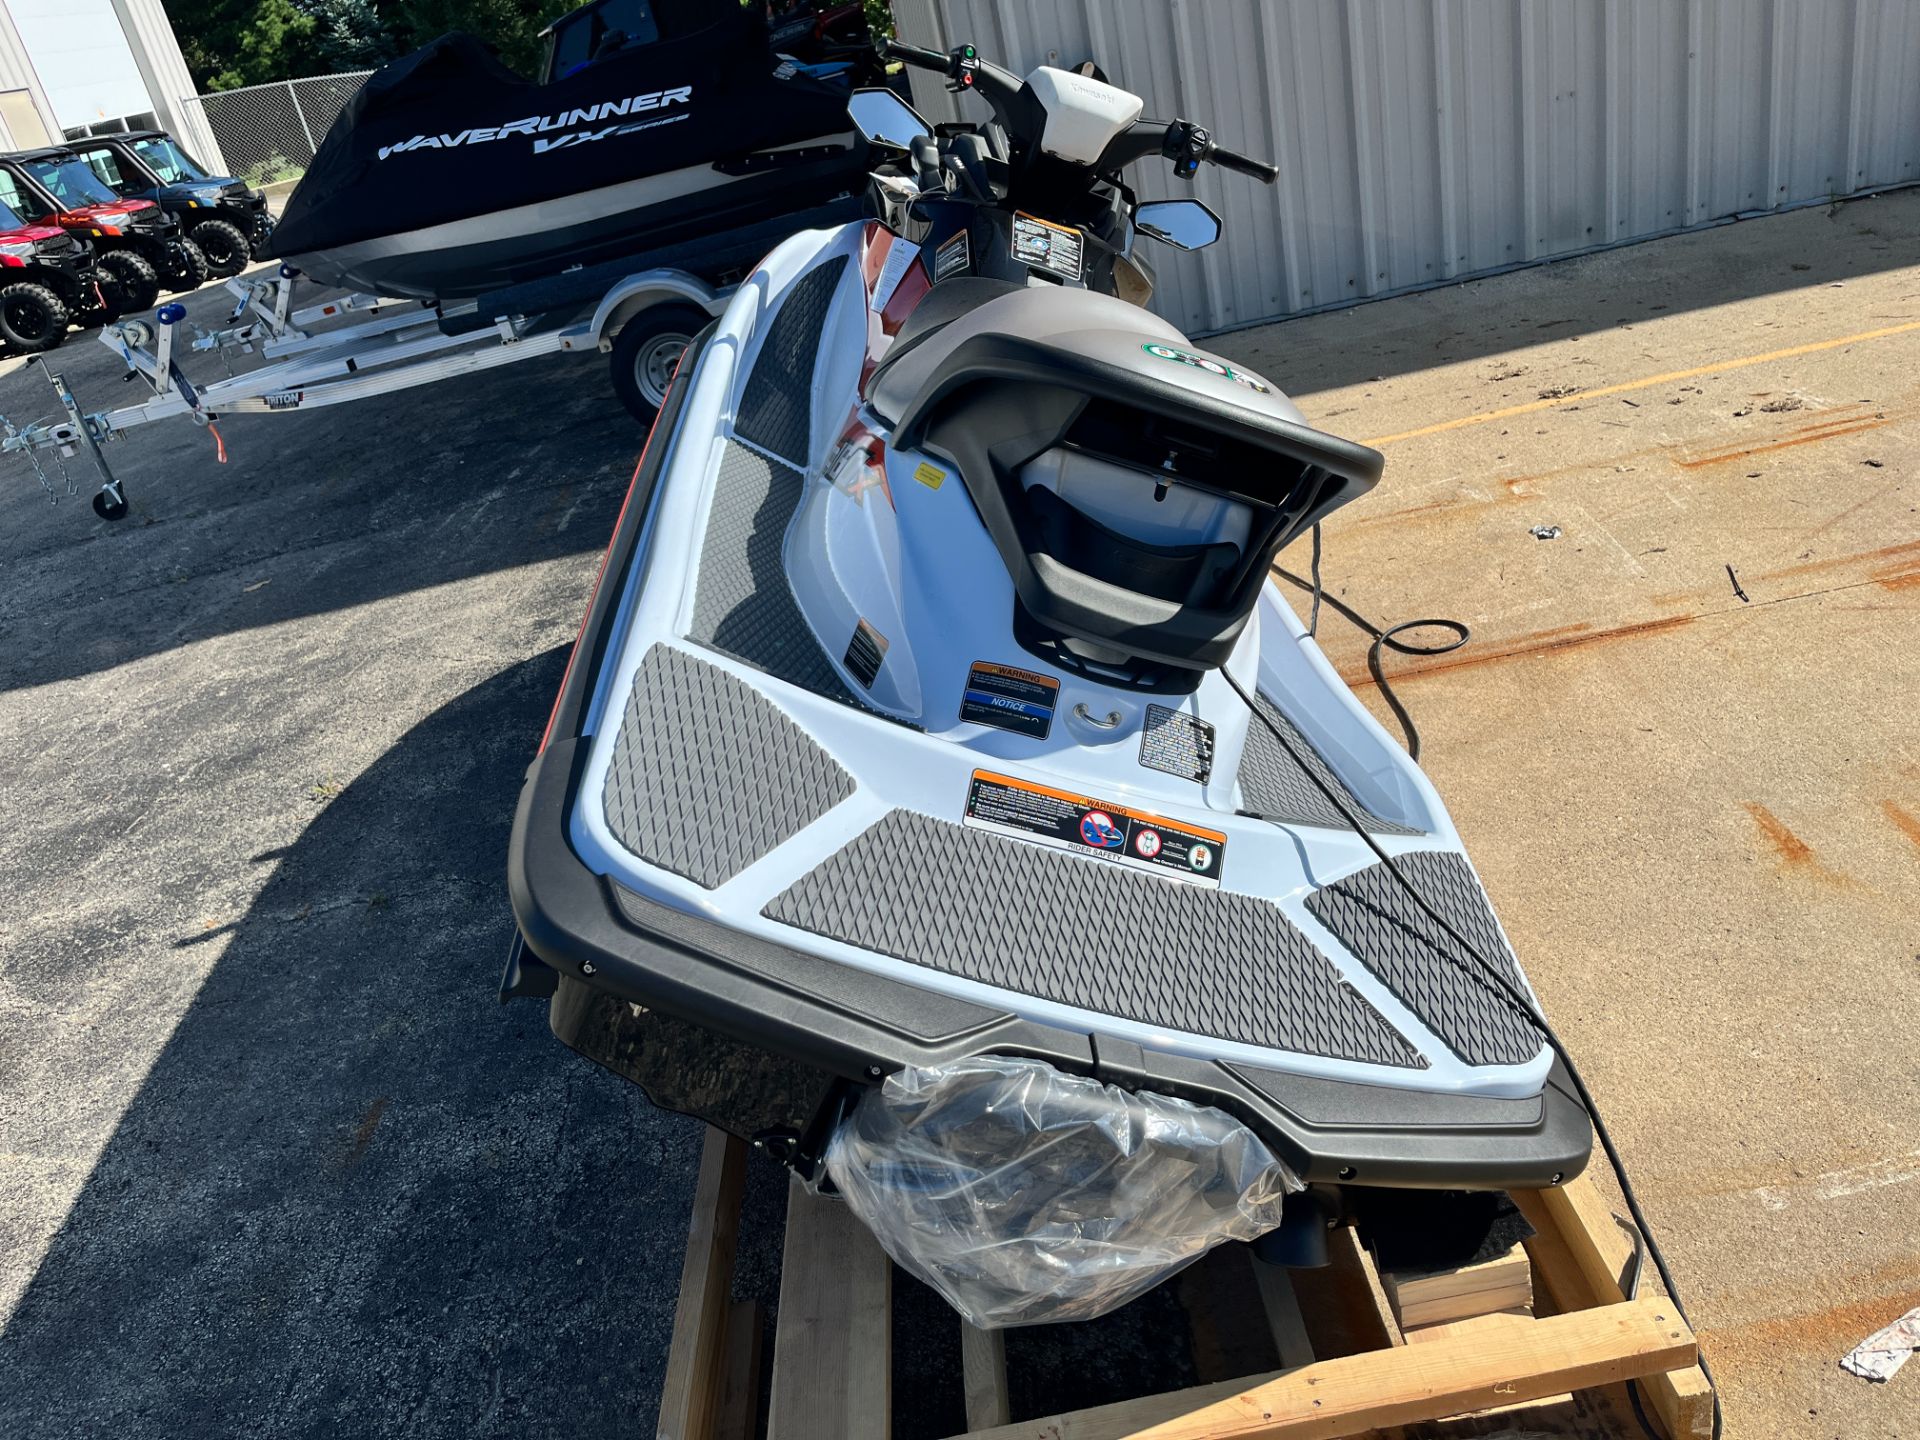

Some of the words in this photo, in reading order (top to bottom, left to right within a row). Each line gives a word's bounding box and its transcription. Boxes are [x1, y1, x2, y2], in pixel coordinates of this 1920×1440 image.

[378, 86, 692, 160] WAVERUNNER
[534, 126, 619, 154] VX
[265, 392, 299, 405] TRITON
[999, 666, 1040, 683] WARNING
[991, 698, 1026, 712] NOTICE
[1087, 798, 1127, 815] WARNING
[1067, 842, 1092, 854] RIDER
[1092, 848, 1122, 861] SAFETY
